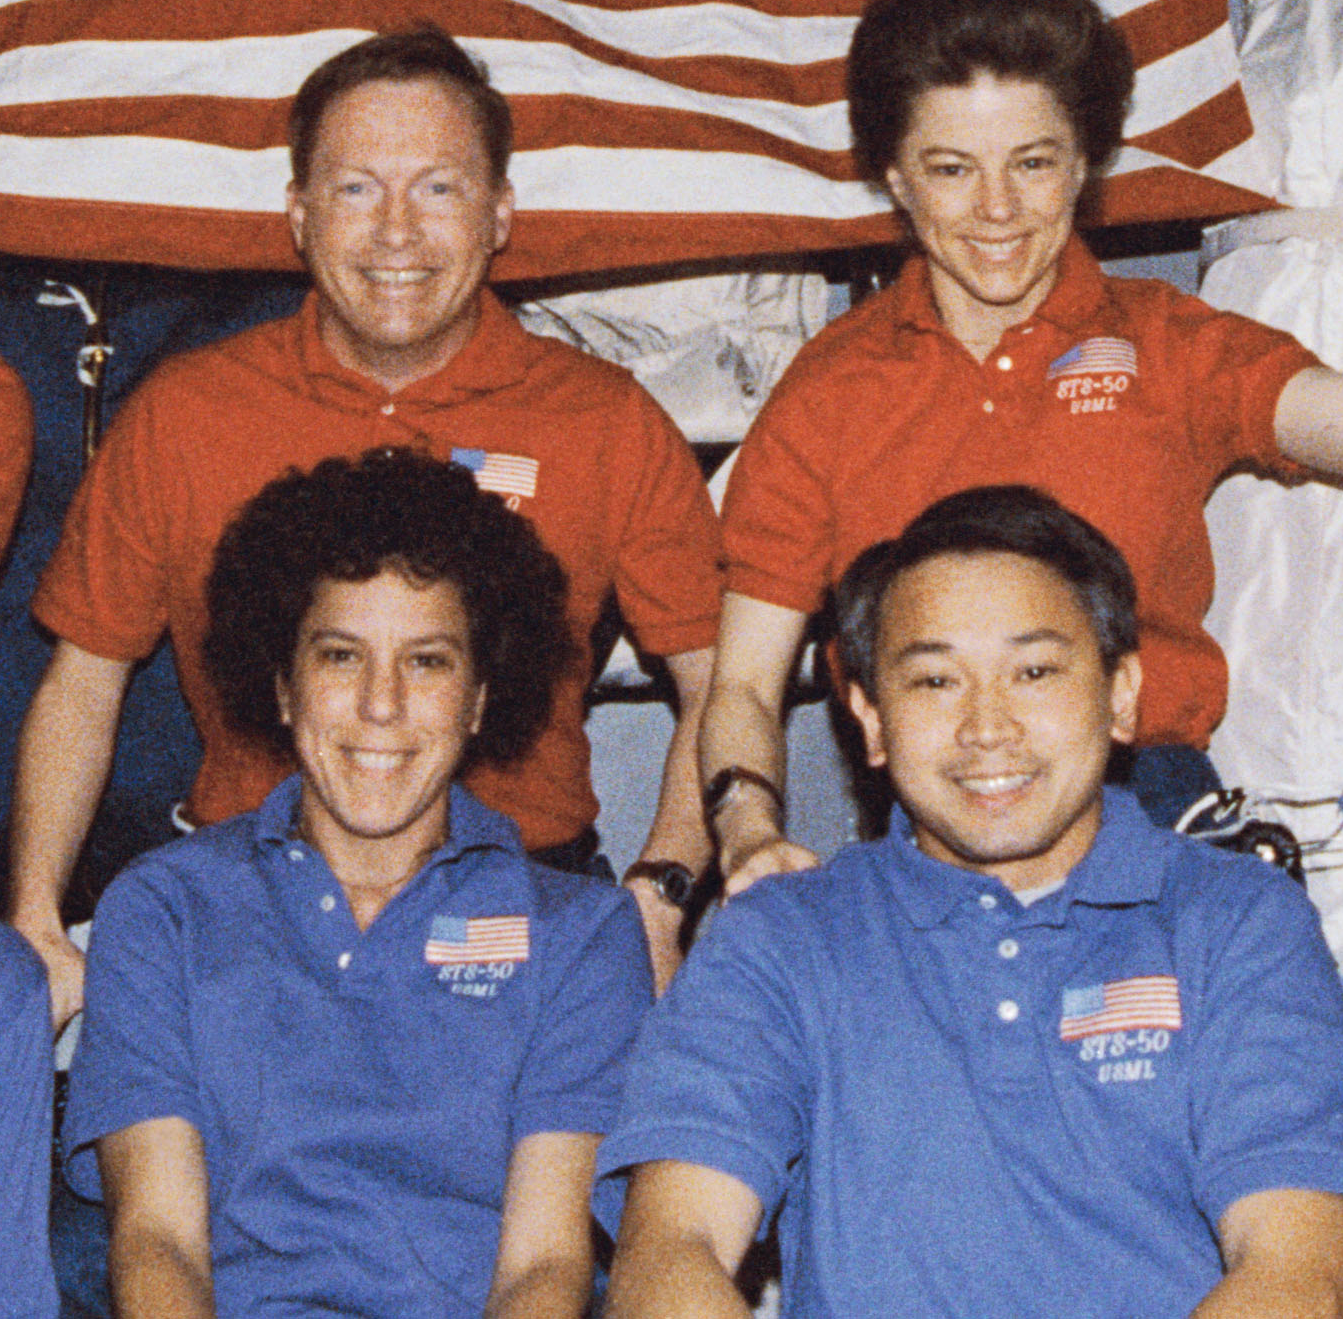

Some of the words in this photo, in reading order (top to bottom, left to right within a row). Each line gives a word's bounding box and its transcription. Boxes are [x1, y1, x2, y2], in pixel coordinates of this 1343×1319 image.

[1056, 375, 1129, 399] STS-50
[438, 962, 514, 981] STS-50
[1079, 1028, 1170, 1061] STS-50
[1098, 1058, 1156, 1084] USML
